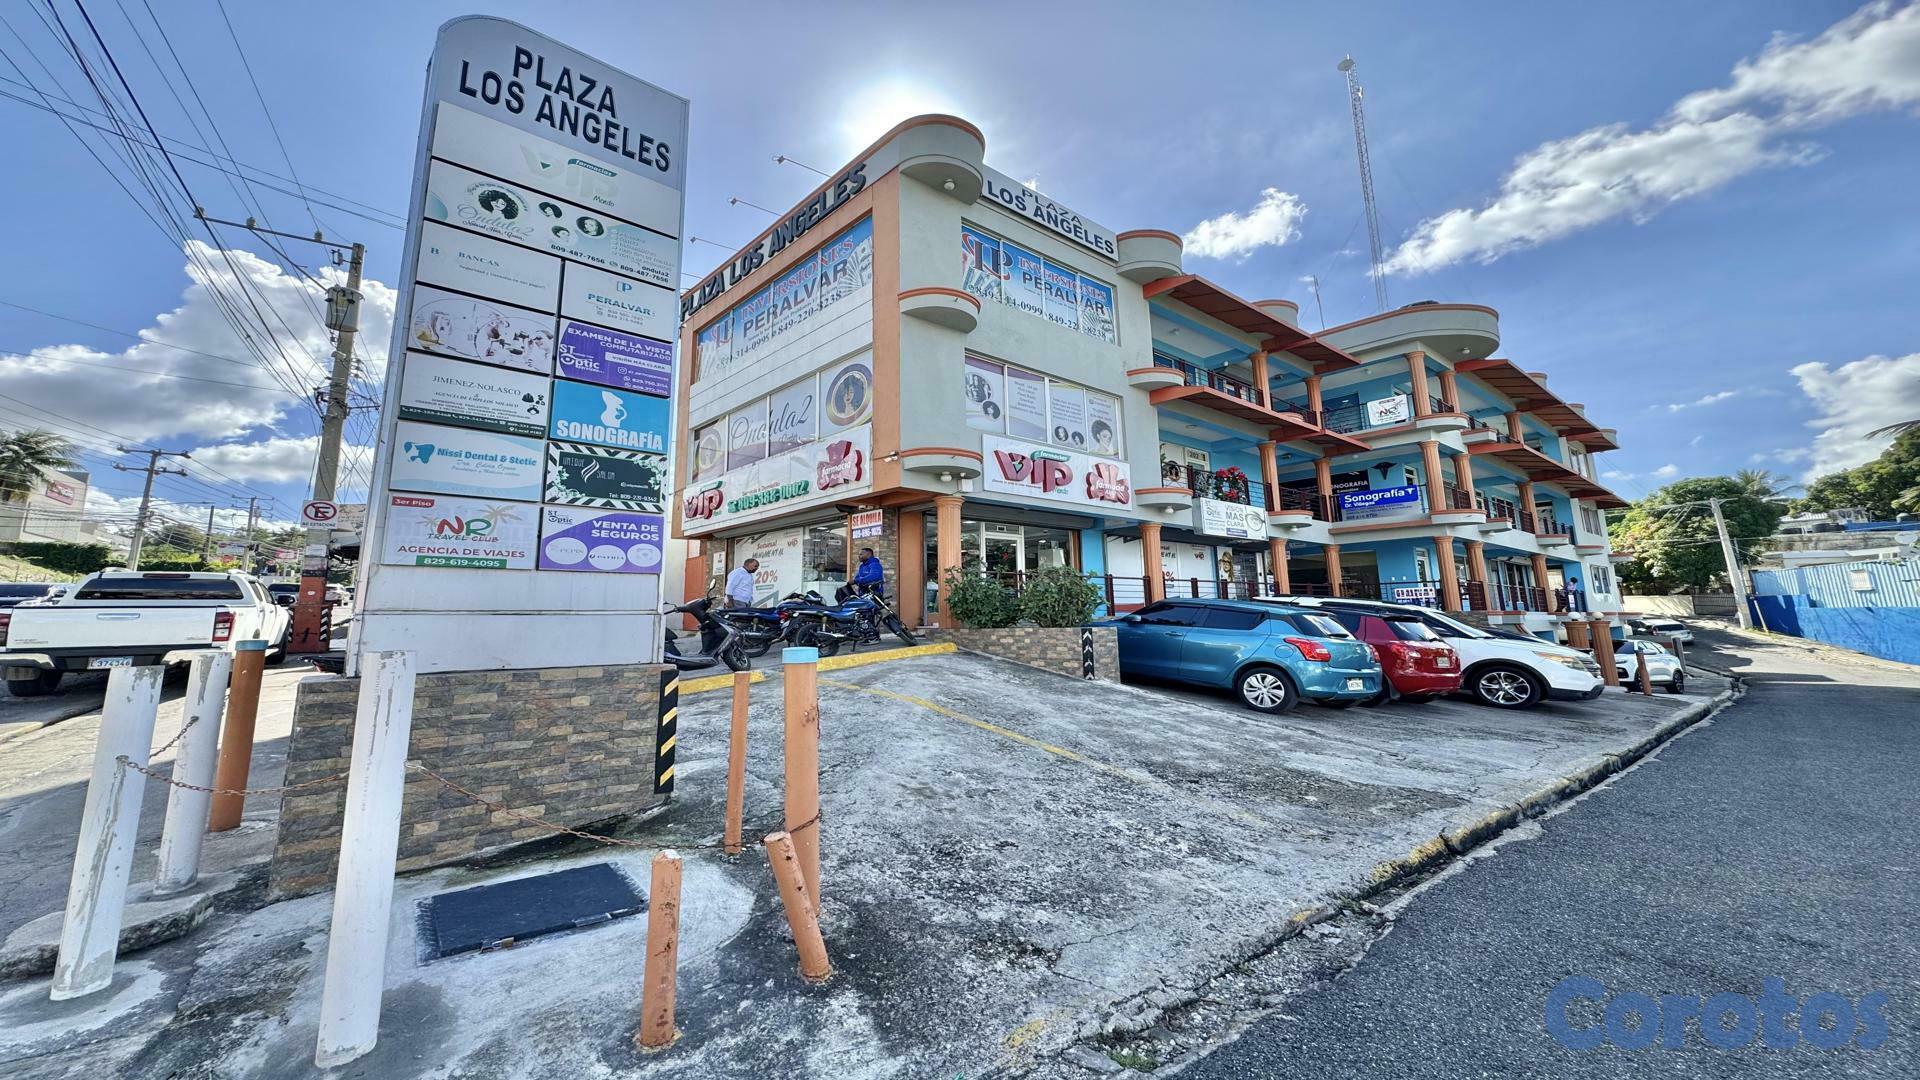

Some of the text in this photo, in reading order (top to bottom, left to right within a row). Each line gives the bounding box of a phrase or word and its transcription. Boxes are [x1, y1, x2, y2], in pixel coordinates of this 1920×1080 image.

[512, 44, 617, 119] PLAZA
[459, 59, 671, 173] LOS ANGELES
[1021, 188, 1083, 226] PLAZA
[987, 180, 1115, 255] LOS ANGELES
[680, 271, 726, 323] PLAZA
[729, 241, 765, 286] LOS
[767, 161, 867, 258] ANGELES
[458, 251, 500, 267] BANCAS
[551, 243, 606, 265] 809-487-7656
[619, 264, 669, 283] 809-487-7656
[641, 265, 670, 277] ondula2
[743, 258, 848, 338] PERALVAR
[1022, 271, 1106, 316] PERALVAR
[587, 293, 651, 316] PERALVAR
[559, 343, 576, 354] ST
[567, 328, 672, 356] EXAMEN DE LA VISTA
[600, 341, 671, 361] COMPUTARIZADO
[556, 419, 663, 449] SONOGRAFÍA
[437, 447, 537, 466] Nissi Dental & Stetic
[562, 456, 585, 467] UNIQUE
[823, 460, 851, 475] farmacia
[993, 449, 1073, 493] VIP
[1095, 479, 1125, 492] farmacia
[412, 499, 432, 507] Piso
[684, 488, 724, 520] VIP
[1344, 488, 1405, 503] Sonografía
[436, 515, 492, 537] NR
[1225, 511, 1245, 522] MAS
[1226, 520, 1245, 528] CLARA
[591, 529, 660, 541] SEGUROS
[592, 520, 659, 533] VENTA DE
[426, 533, 469, 541] TRAVEL
[397, 545, 526, 558] AGENCIA DE VIAJES
[423, 557, 500, 567] 829-619-4095
[755, 569, 778, 585] 20%
